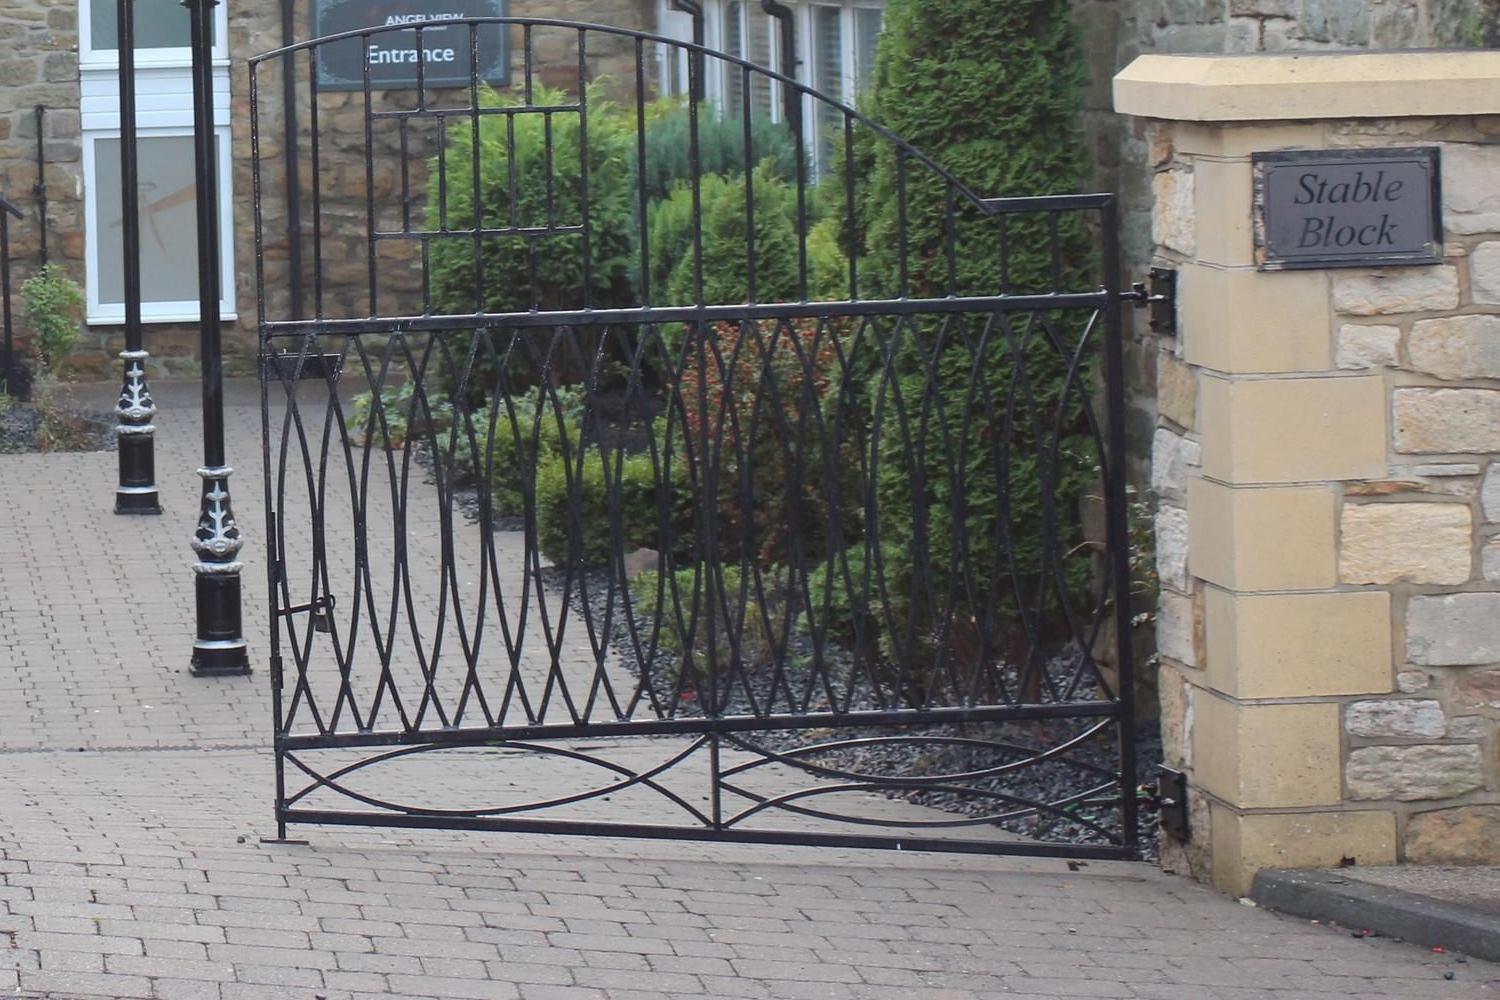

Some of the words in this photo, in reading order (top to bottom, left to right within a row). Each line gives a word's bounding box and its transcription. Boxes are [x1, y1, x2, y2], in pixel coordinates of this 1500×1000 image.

[368, 45, 455, 64] Entrance
[1294, 170, 1403, 205] Stable
[1297, 214, 1398, 248] Block
